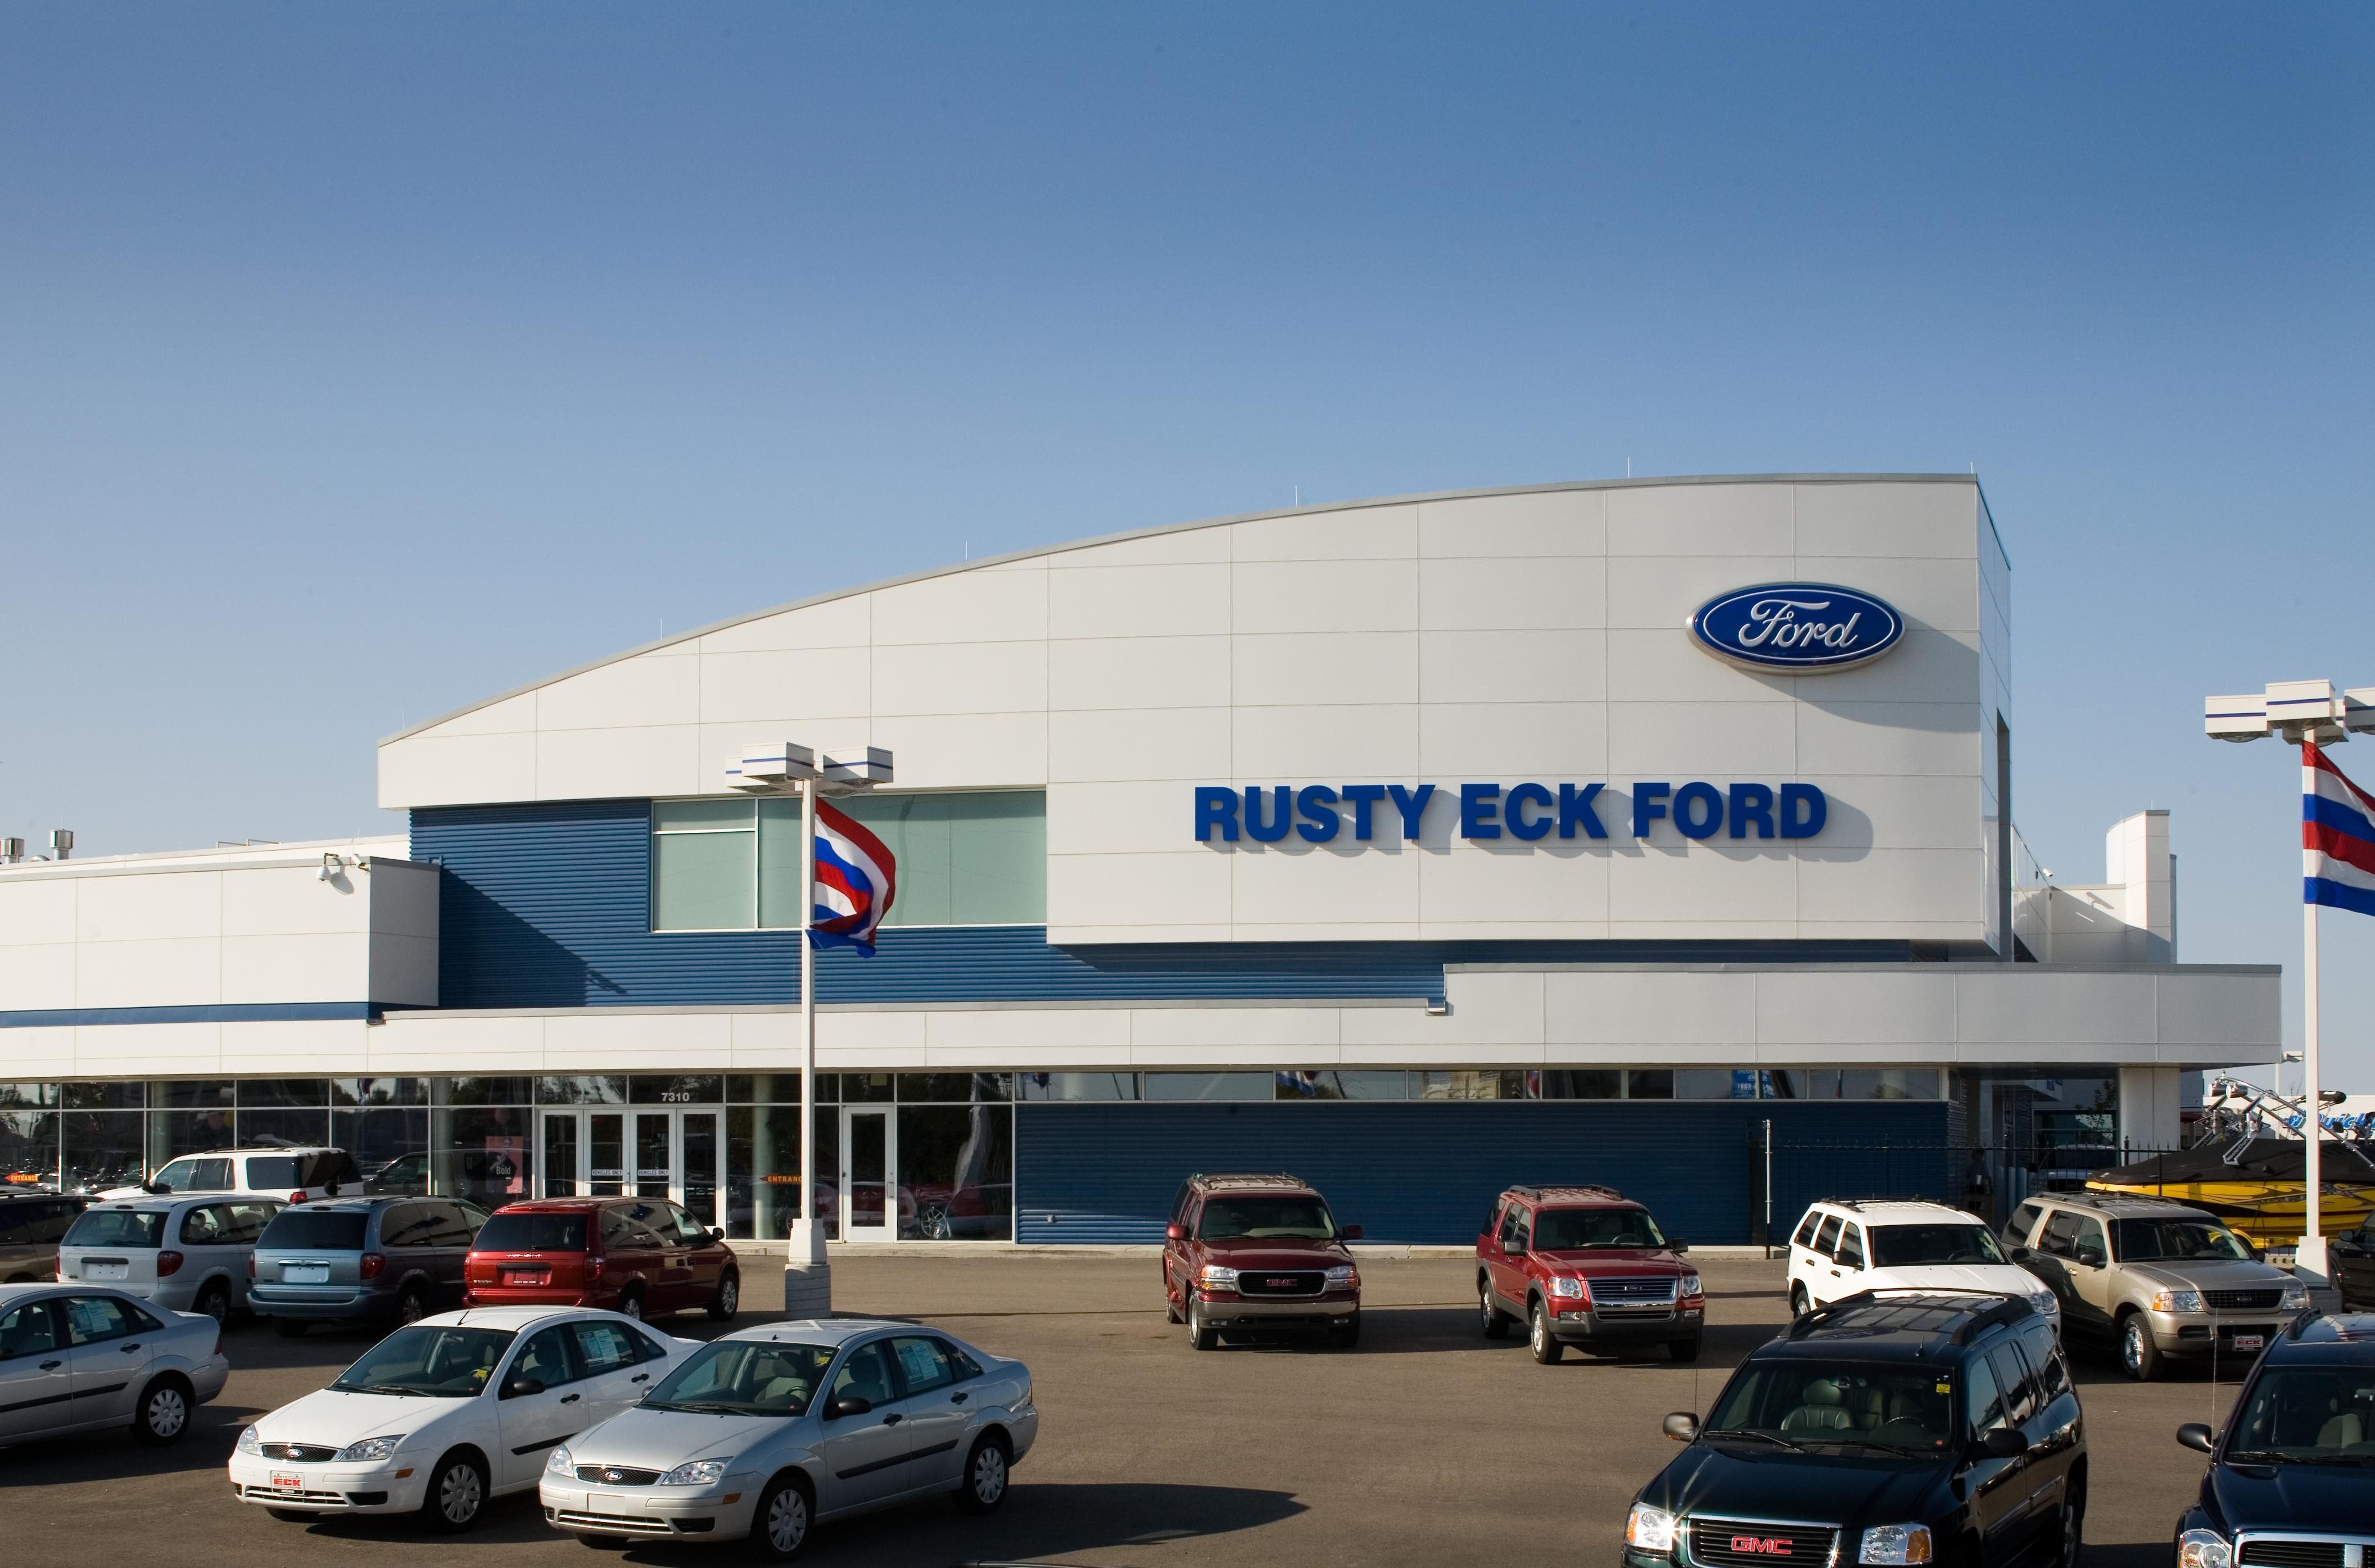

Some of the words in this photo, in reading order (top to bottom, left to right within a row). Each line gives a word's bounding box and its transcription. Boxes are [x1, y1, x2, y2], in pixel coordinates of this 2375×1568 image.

[1739, 599, 1861, 647] Ford
[1195, 785, 1435, 842] RUSTY
[1460, 783, 1607, 840] ECK
[1633, 782, 1826, 839] FORD
[661, 1092, 690, 1102] 7310
[2318, 1113, 2367, 1129] uick
[496, 1166, 511, 1175] Bold
[274, 1478, 301, 1487] ECK
[1731, 1536, 1793, 1554] GMC
